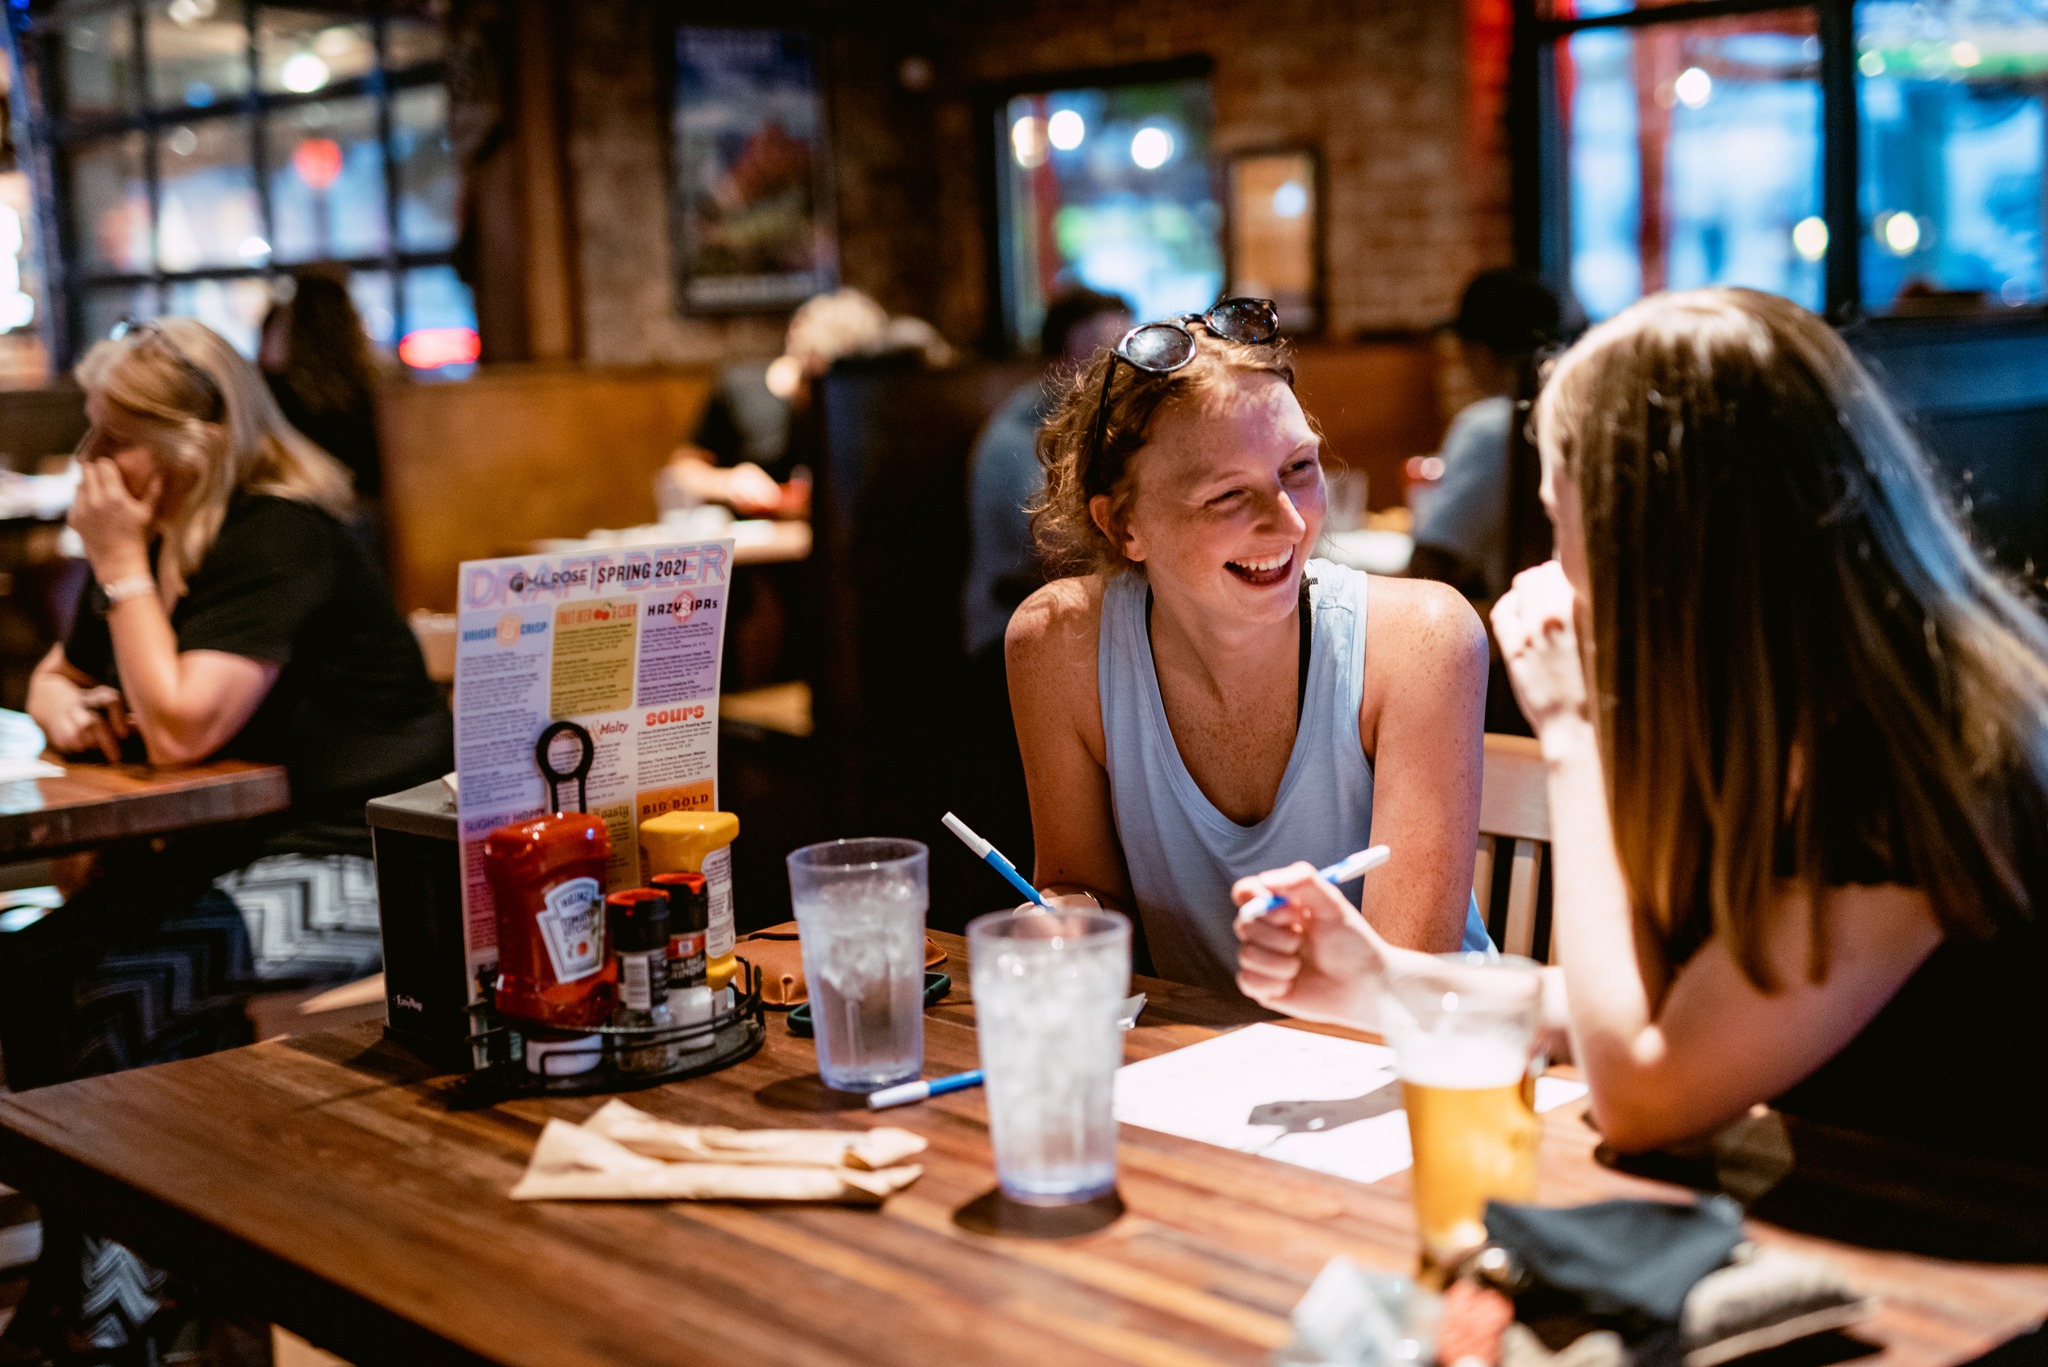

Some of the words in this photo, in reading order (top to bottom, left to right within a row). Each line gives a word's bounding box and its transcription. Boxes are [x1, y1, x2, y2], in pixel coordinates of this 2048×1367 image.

[464, 554, 613, 609] DRAFT
[621, 543, 727, 592] BEER
[551, 568, 587, 584] ROSE
[597, 562, 651, 584] SPRING
[655, 558, 687, 578] 2021
[647, 601, 682, 616] HAZY
[690, 598, 718, 611] IPAs
[462, 627, 497, 642] BRIGHT
[521, 621, 548, 636] CRISP
[600, 719, 629, 735] Malty
[645, 705, 705, 727] sours
[643, 801, 667, 815] BIG
[673, 793, 709, 809] BOLD
